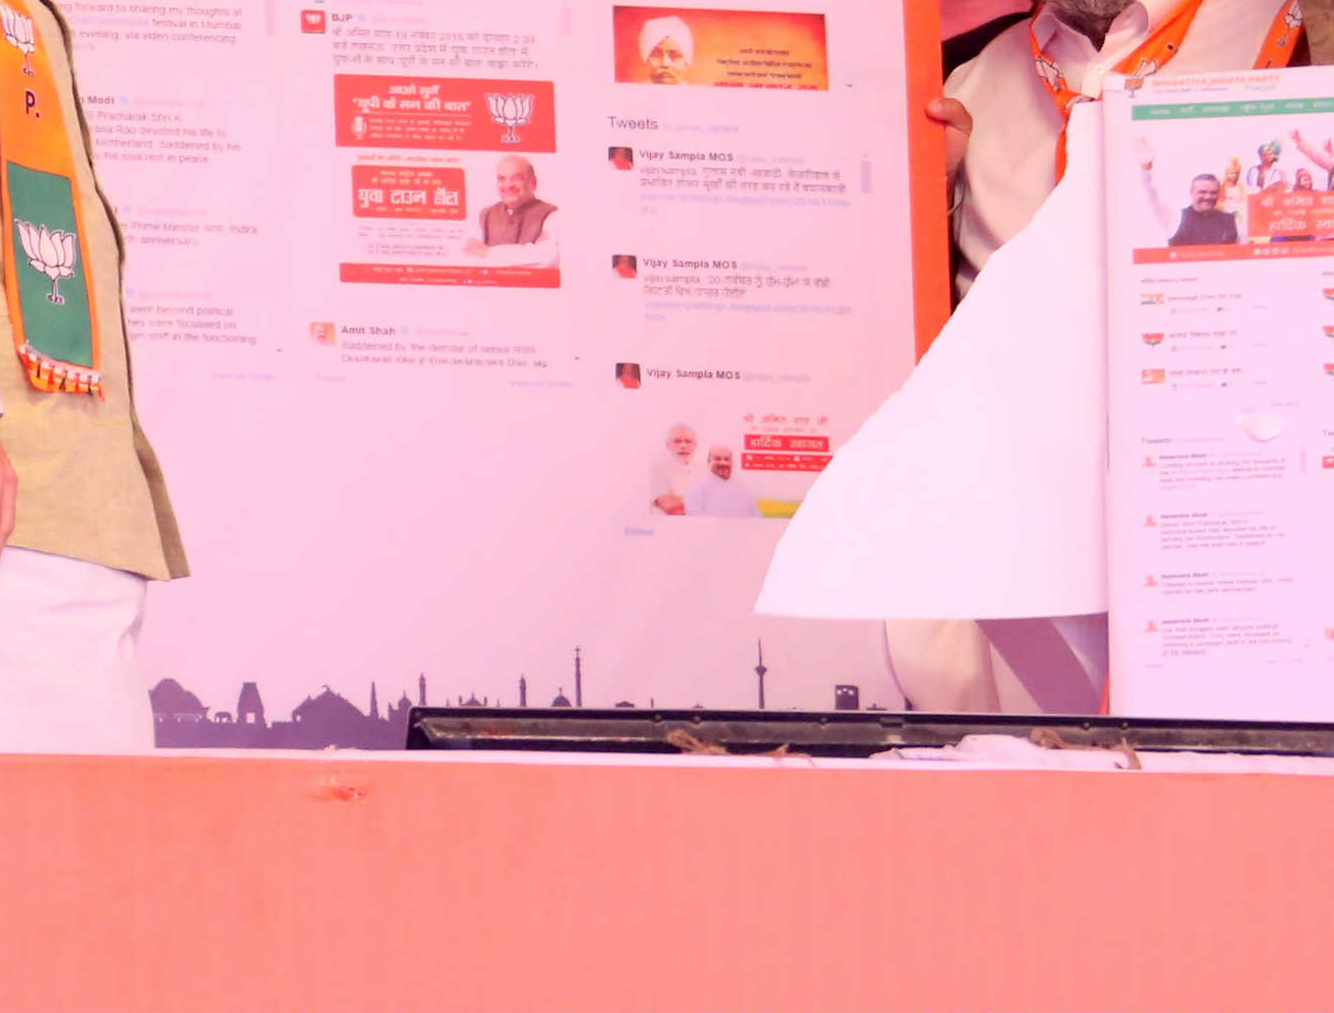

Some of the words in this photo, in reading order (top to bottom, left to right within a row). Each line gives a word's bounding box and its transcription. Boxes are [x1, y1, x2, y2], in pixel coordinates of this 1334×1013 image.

[331, 13, 353, 23] BJP
[24, 89, 43, 119] P.
[87, 96, 115, 105] Modi
[608, 116, 659, 131] Tweets
[639, 149, 665, 161] Vijay
[668, 151, 706, 163] Sampla
[709, 152, 734, 163] MOS
[357, 188, 384, 208] युवा
[390, 188, 426, 205] टाउन
[434, 186, 459, 206] हॉल
[642, 258, 667, 269] Vijay
[672, 259, 709, 271] Sampla
[712, 260, 738, 270] MOS
[341, 325, 366, 336] Amit
[369, 326, 396, 337] Shah
[646, 368, 672, 380] Vijay
[675, 369, 713, 381] Sampla
[716, 370, 741, 381] MOS
